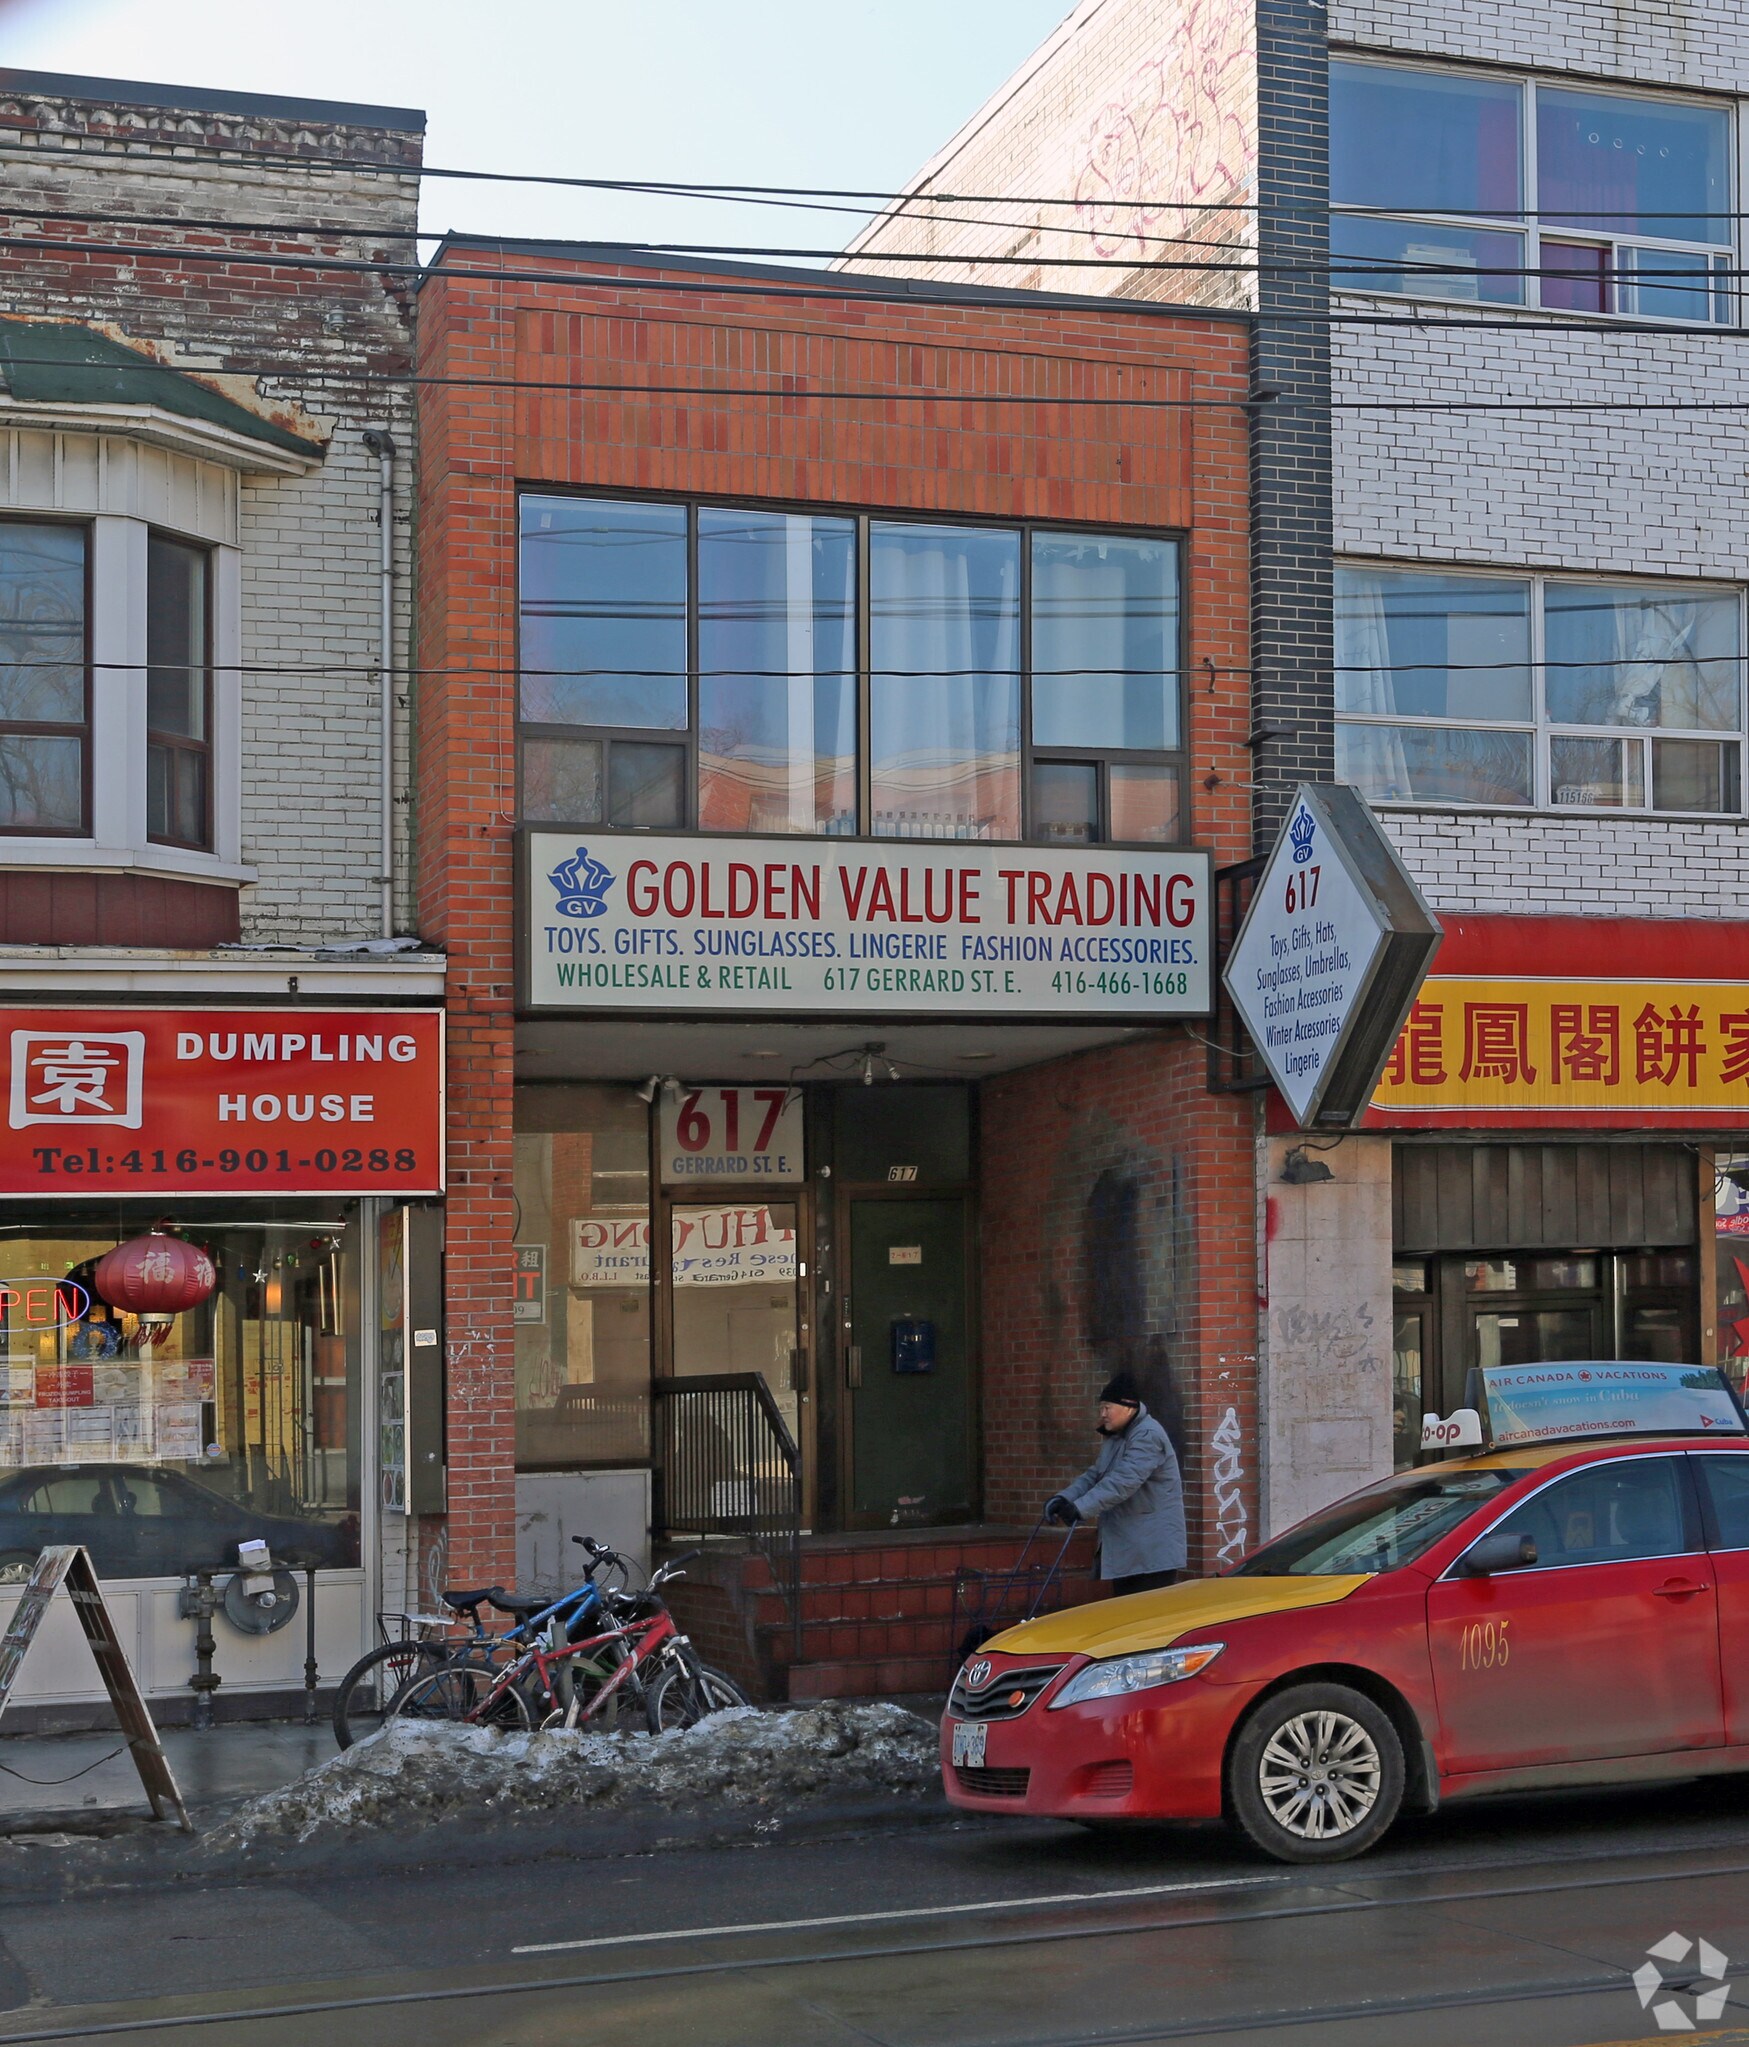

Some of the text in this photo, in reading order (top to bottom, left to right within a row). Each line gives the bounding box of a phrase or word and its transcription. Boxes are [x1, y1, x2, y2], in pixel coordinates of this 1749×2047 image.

[1296, 847, 1310, 862] GV
[626, 860, 1196, 928] GOLDEN VALUE TRADING
[1284, 865, 1321, 914] 617
[566, 901, 597, 915] GV
[544, 927, 1198, 965] TOYS. GIFTS. SUNGLASSES. LINGERIE FASHION ACCESSORIES.
[1270, 921, 1337, 960] Toys, Gifts, Hats,
[557, 963, 1187, 995] WHOLESALE & RETAIL 617 GERRARD ST. E. 416-466-1668
[1257, 946, 1351, 992] Sunglasses, Umbrellas,
[1264, 981, 1343, 1019] Fashion Accessories
[1266, 1013, 1340, 1048] Winter Accessories
[176, 1032, 417, 1062] DUMPLING
[1285, 1048, 1320, 1077] Lingerie
[9, 1029, 146, 1130] 園
[218, 1094, 374, 1122] HOUSE
[676, 1088, 787, 1152] 617
[33, 1147, 417, 1174] Tel:416-901-0288
[672, 1156, 792, 1174] GERRARD ST. E.
[889, 1167, 917, 1181] 617
[1489, 1371, 1667, 1388] AIR CANADA VACATIONS
[1498, 1419, 1636, 1442] aircanadavacations.com
[1459, 1620, 1509, 1671] 1095
